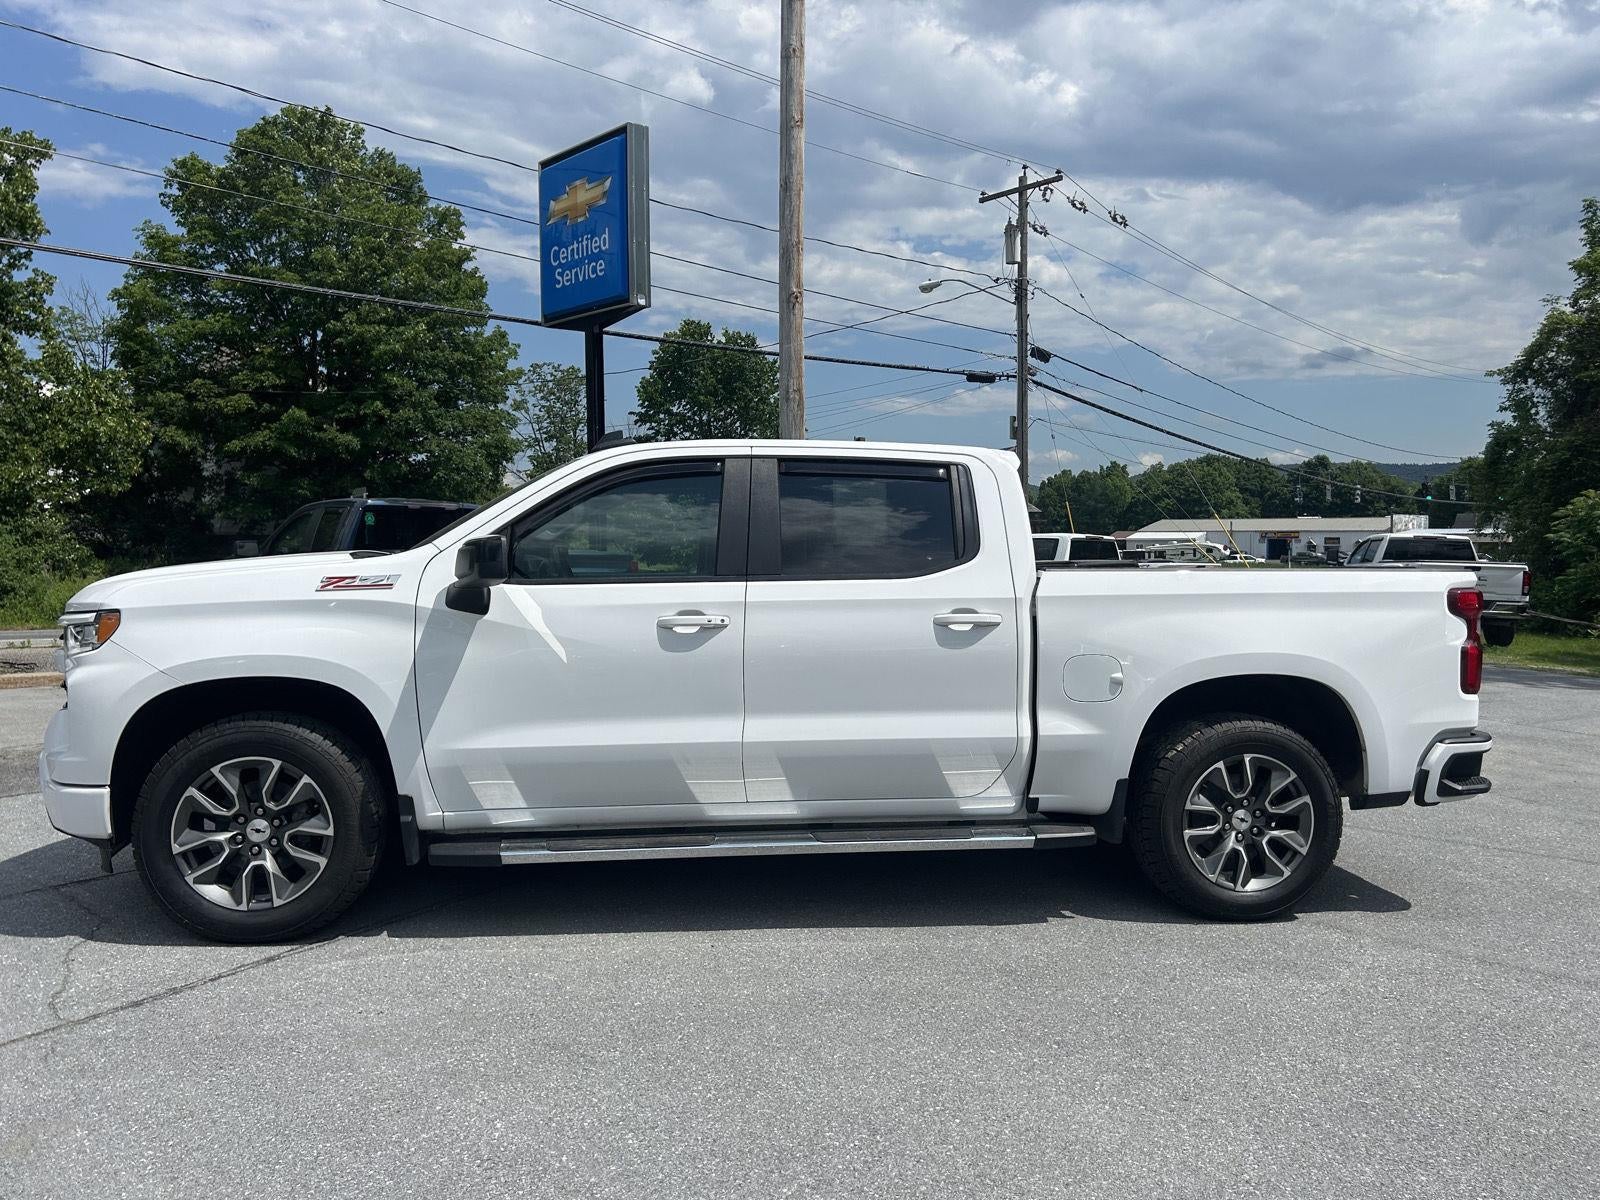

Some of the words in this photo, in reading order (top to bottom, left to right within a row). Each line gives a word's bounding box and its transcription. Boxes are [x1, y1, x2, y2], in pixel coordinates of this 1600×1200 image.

[550, 227, 609, 266] Certified
[555, 259, 605, 288] Service
[315, 574, 401, 592] Z71
